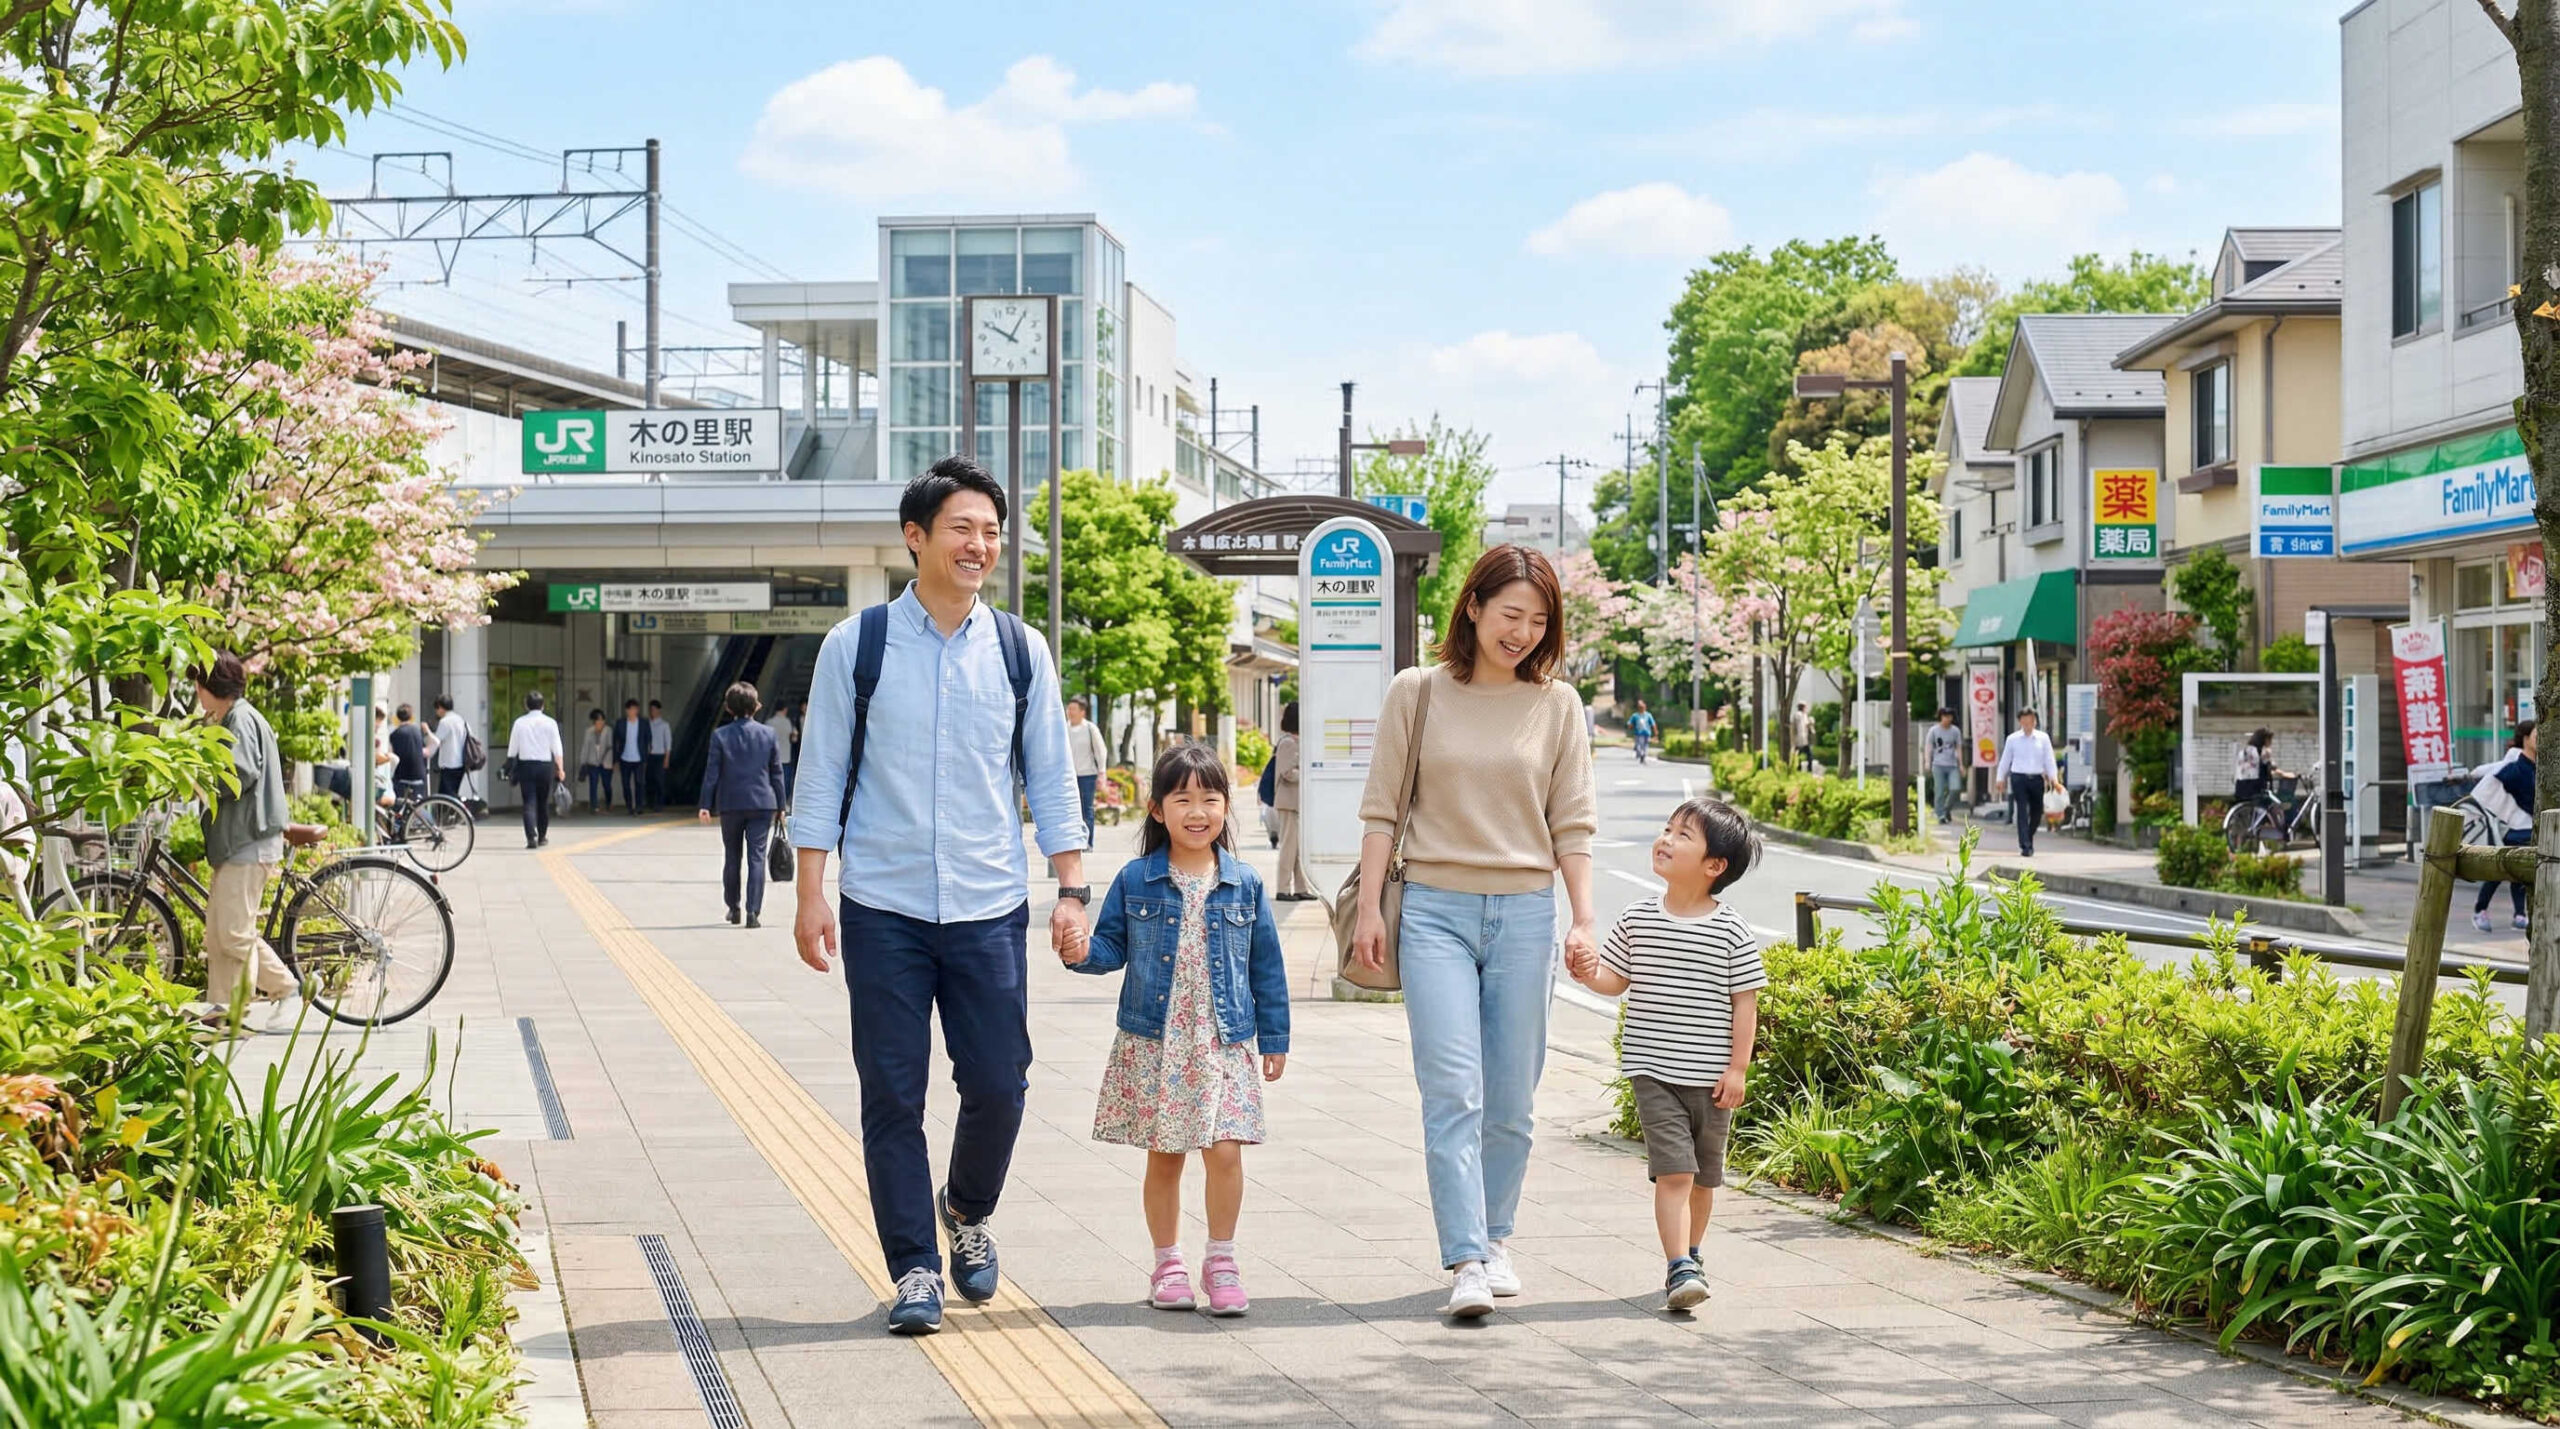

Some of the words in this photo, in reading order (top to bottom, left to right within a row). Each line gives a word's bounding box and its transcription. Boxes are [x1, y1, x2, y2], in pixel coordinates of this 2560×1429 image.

[535, 419, 595, 453] JR
[629, 418, 753, 447] 木の里駅
[630, 451, 695, 464] Kinosato
[699, 450, 752, 464] Station
[2102, 474, 2148, 519] 薬
[2262, 503, 2331, 518] FamilyMart
[1331, 537, 1360, 554] JR
[2099, 527, 2152, 555] 薬局
[1320, 558, 1373, 571] FamilyMart
[638, 587, 690, 601] 木の里駅
[1317, 580, 1376, 595] 木の里駅
[567, 587, 597, 606] JR
